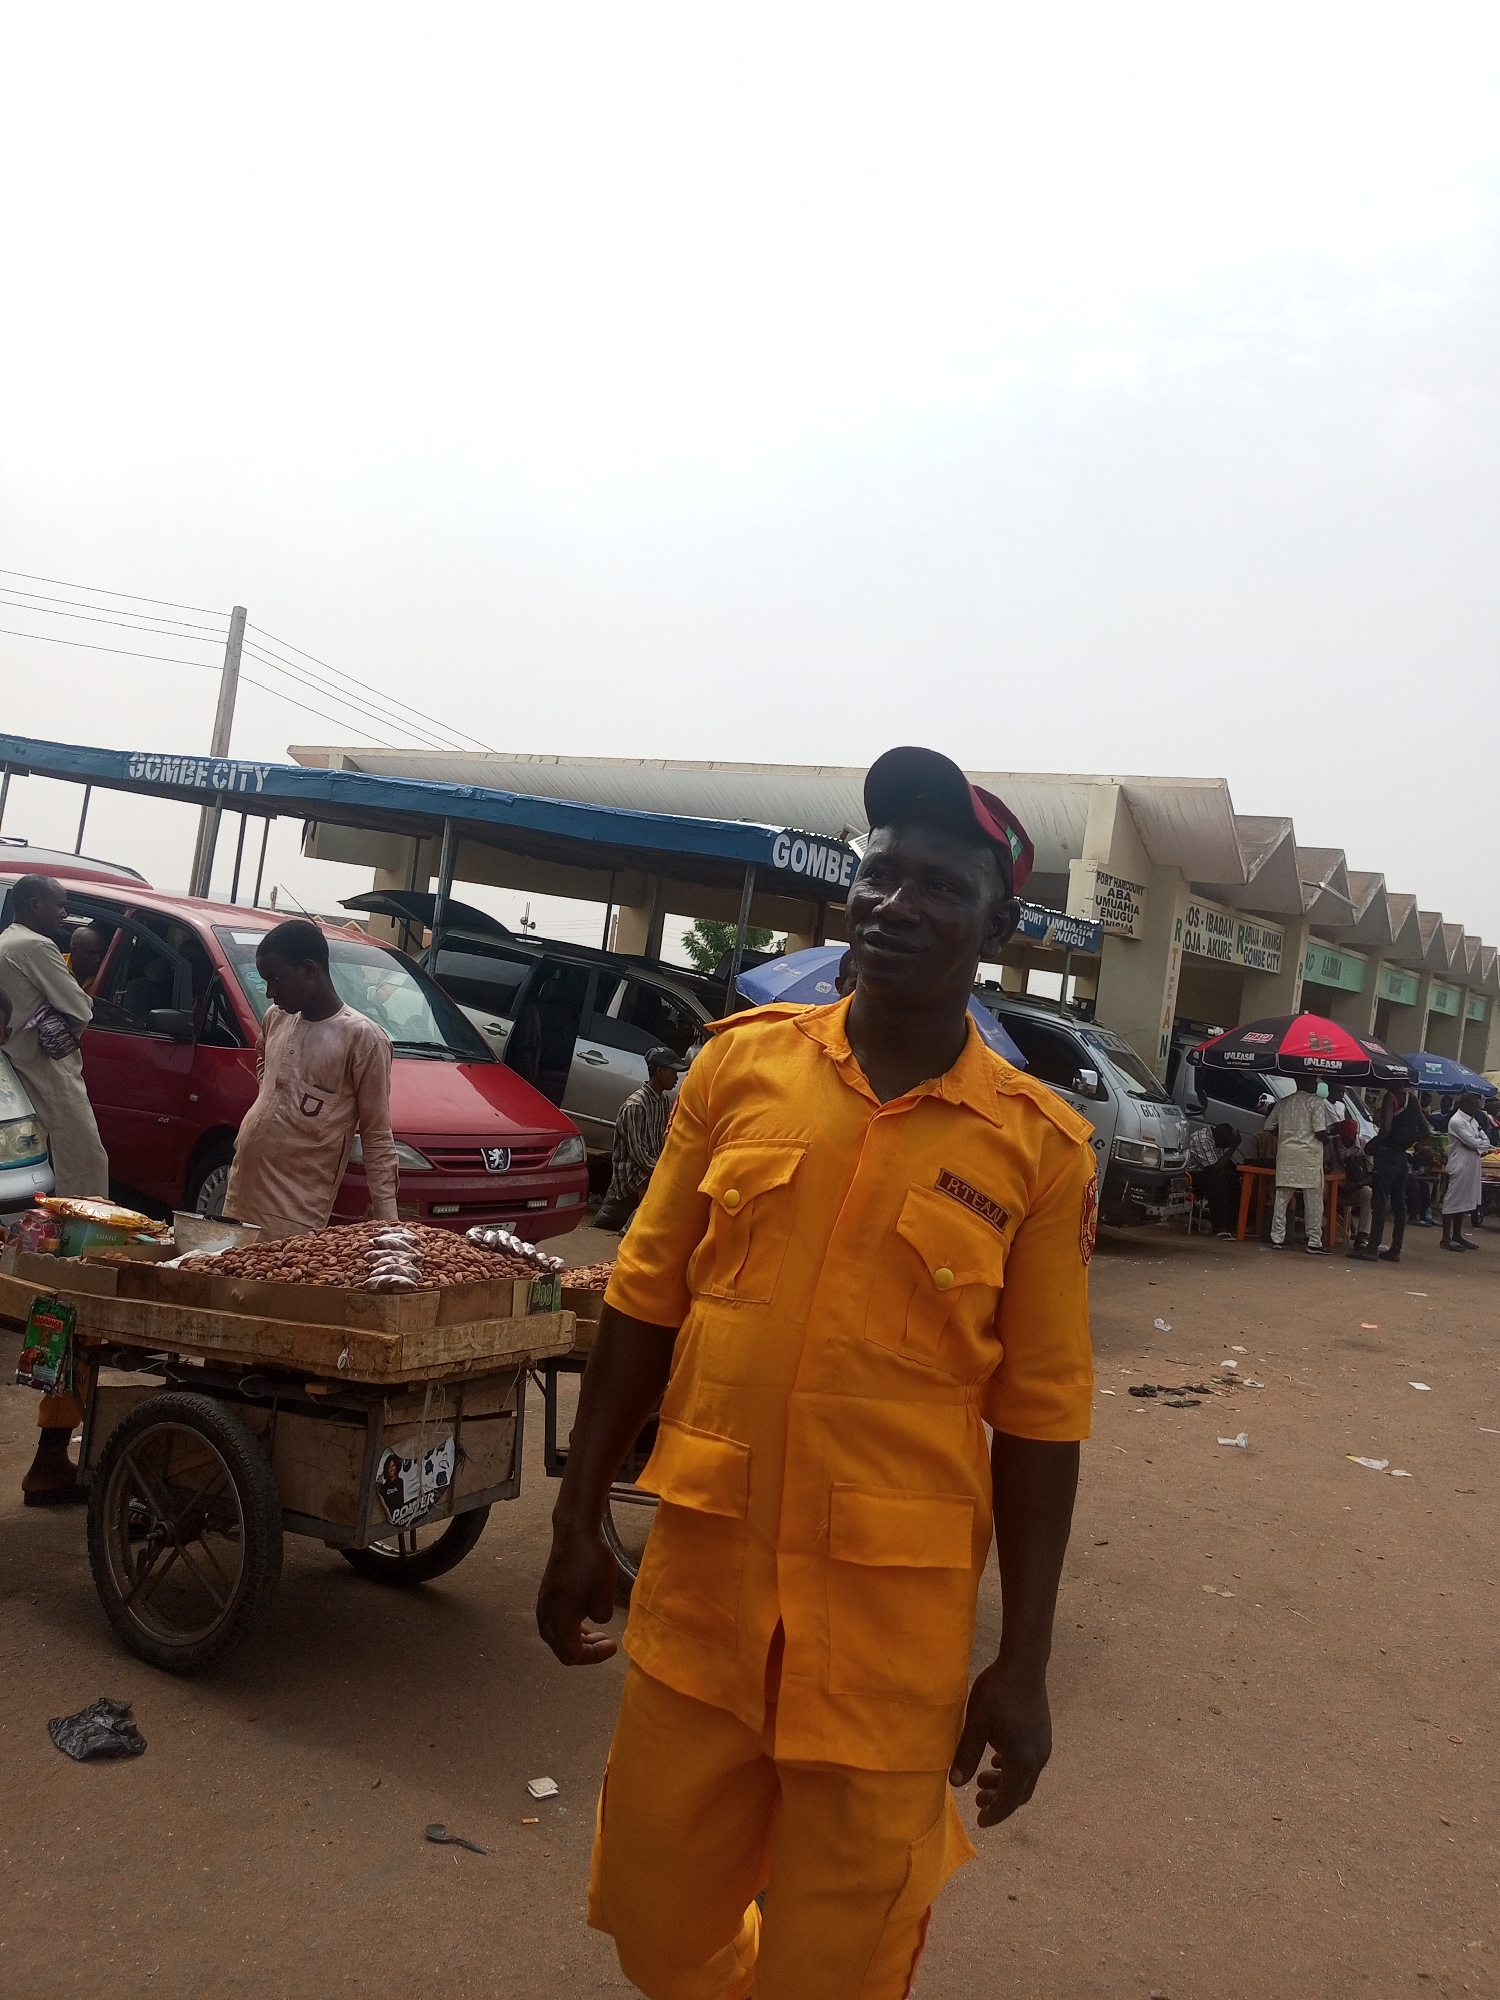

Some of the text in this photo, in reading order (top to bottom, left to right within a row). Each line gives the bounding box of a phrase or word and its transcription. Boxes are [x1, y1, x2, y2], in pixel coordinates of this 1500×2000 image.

[129, 751, 272, 792] GOMBE CITY
[772, 833, 854, 887] GOMBE
[1096, 871, 1113, 886] PORT
[1095, 895, 1140, 915] UMUAHIA
[1107, 888, 1131, 902] ABA
[1020, 908, 1043, 926] COURT
[1100, 907, 1134, 923] ENUGU
[1205, 912, 1235, 939] IBADAN
[1206, 937, 1233, 960] AKURE
[1243, 946, 1281, 971] GOMBE CITY
[1223, 1051, 1256, 1061] UNLEASH
[1303, 1057, 1343, 1070] UNLEASH
[946, 1177, 1004, 1223] RTEAN
